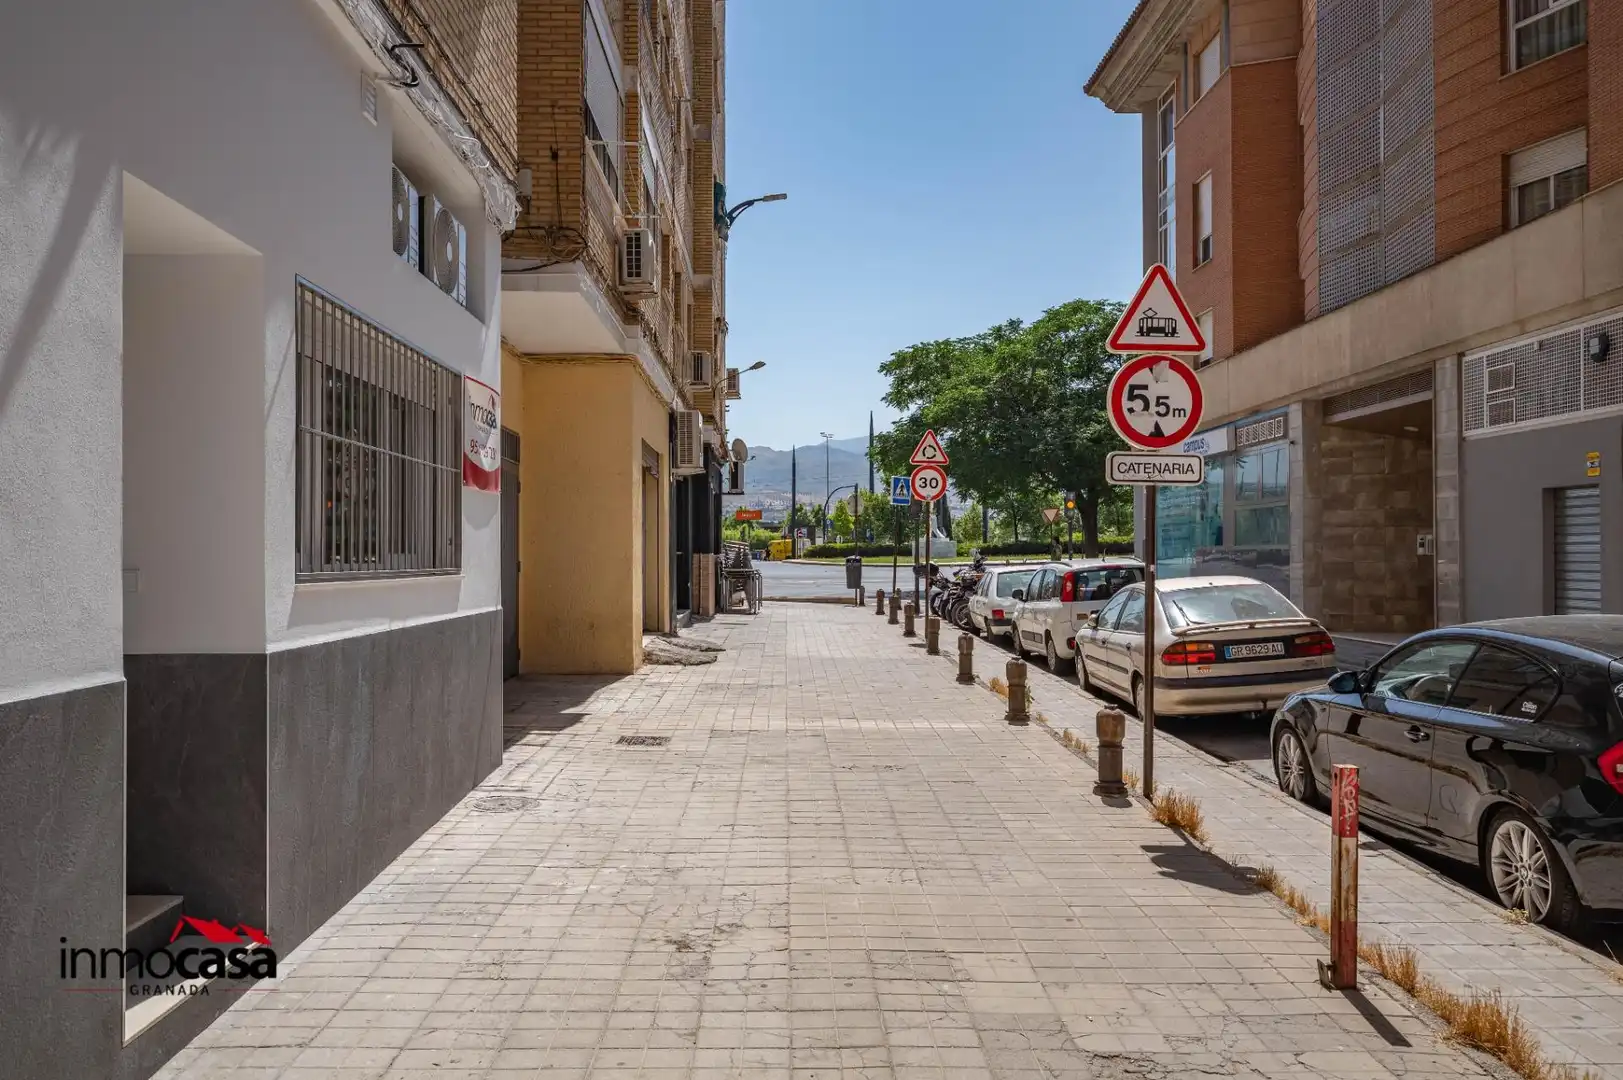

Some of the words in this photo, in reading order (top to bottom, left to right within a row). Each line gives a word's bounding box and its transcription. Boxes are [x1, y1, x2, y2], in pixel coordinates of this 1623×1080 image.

[1117, 461, 1195, 475] CATENARIA
[919, 477, 938, 489] 30
[1231, 647, 1243, 657] GR
[1244, 644, 1269, 656] 9629
[1271, 643, 1283, 654] AU
